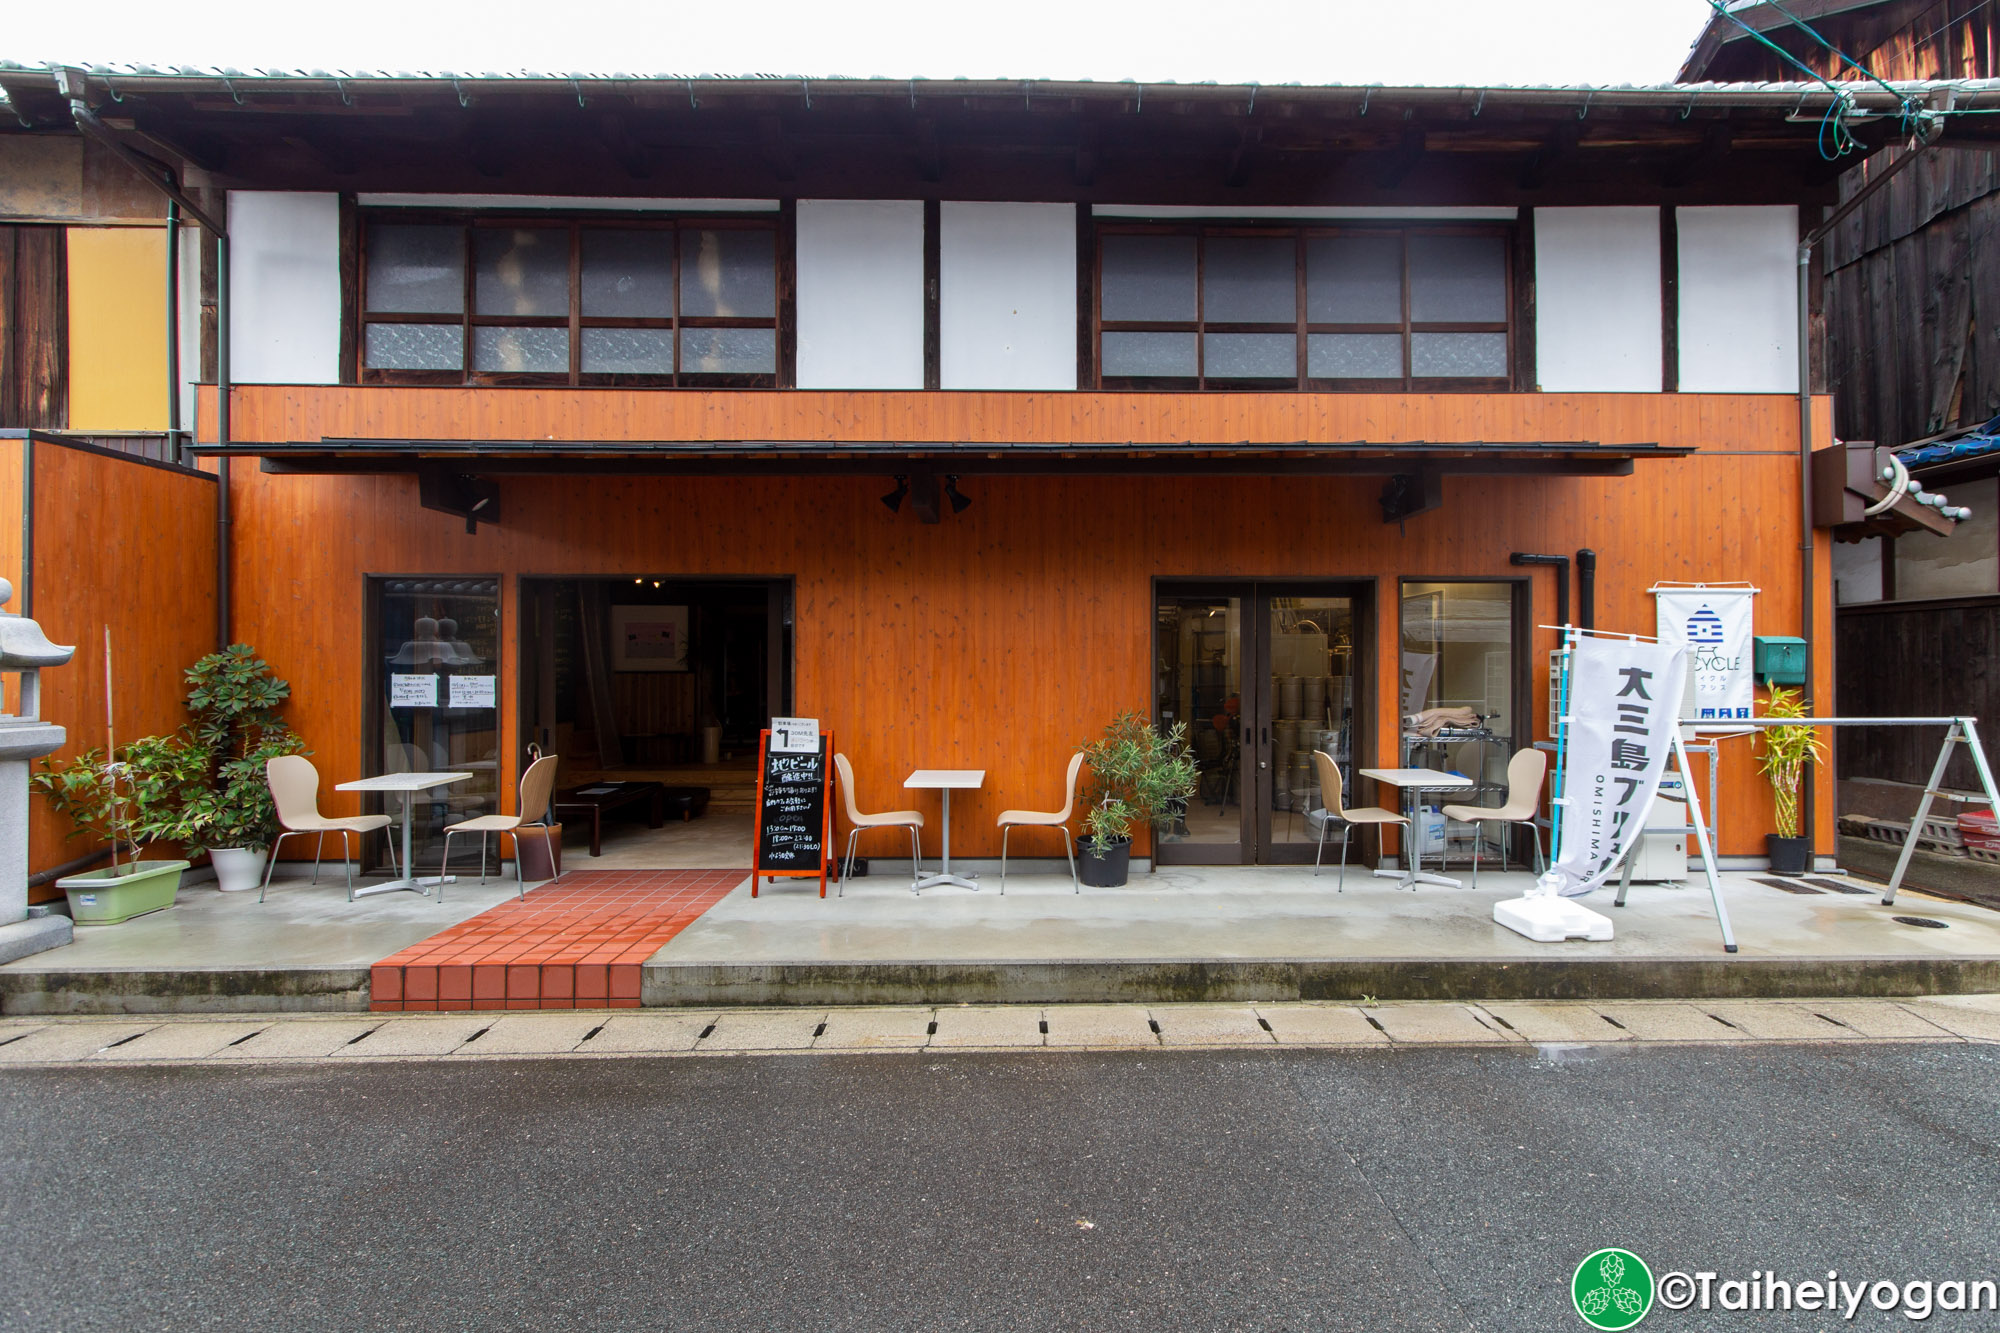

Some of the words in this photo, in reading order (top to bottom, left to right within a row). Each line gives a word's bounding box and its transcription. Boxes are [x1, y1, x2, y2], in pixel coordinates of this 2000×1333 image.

[771, 756, 818, 773] 地ビール
[1599, 667, 1653, 873] 大三島ブリュ
[1590, 774, 1605, 860] OMISHIMA
